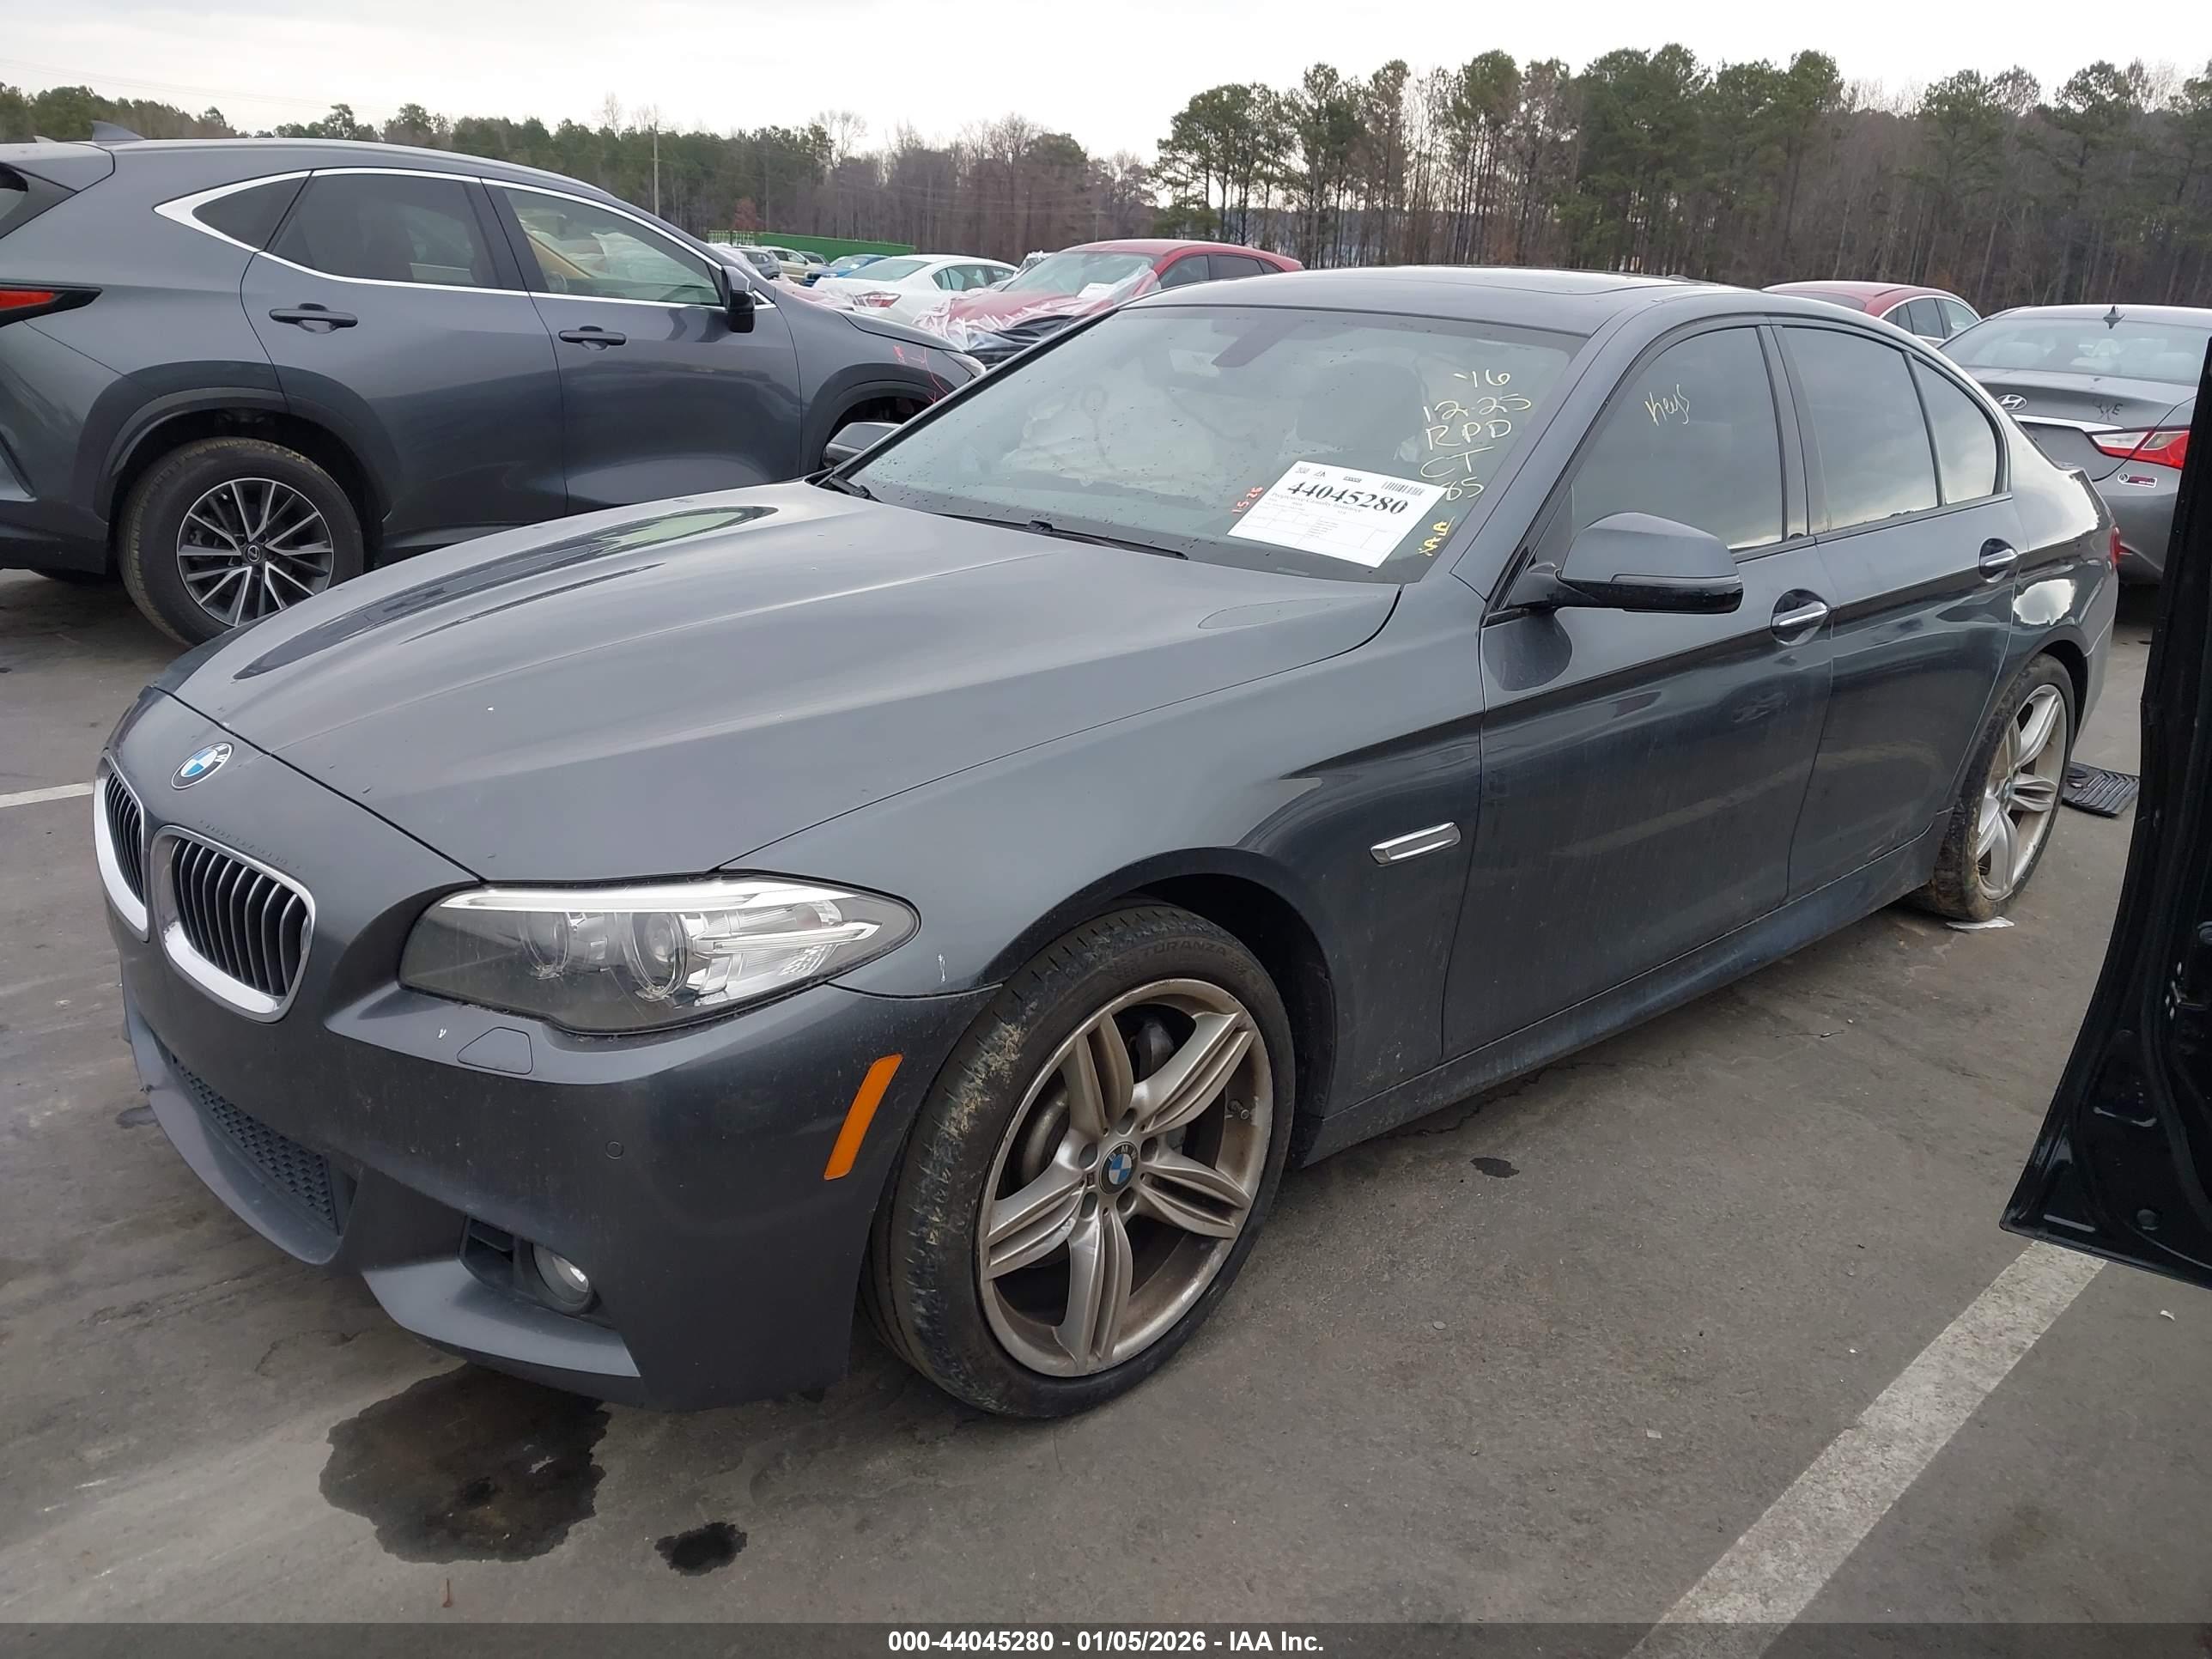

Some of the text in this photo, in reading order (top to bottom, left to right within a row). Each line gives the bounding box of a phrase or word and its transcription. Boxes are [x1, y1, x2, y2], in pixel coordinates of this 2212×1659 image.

[1644, 384, 1690, 426] Keys
[1425, 419, 1512, 451] RPD
[1420, 446, 1495, 478] CT
[1287, 481, 1408, 514] 44045280
[1140, 940, 1227, 957] TURANZA
[1108, 1145, 1138, 1162] BMW
